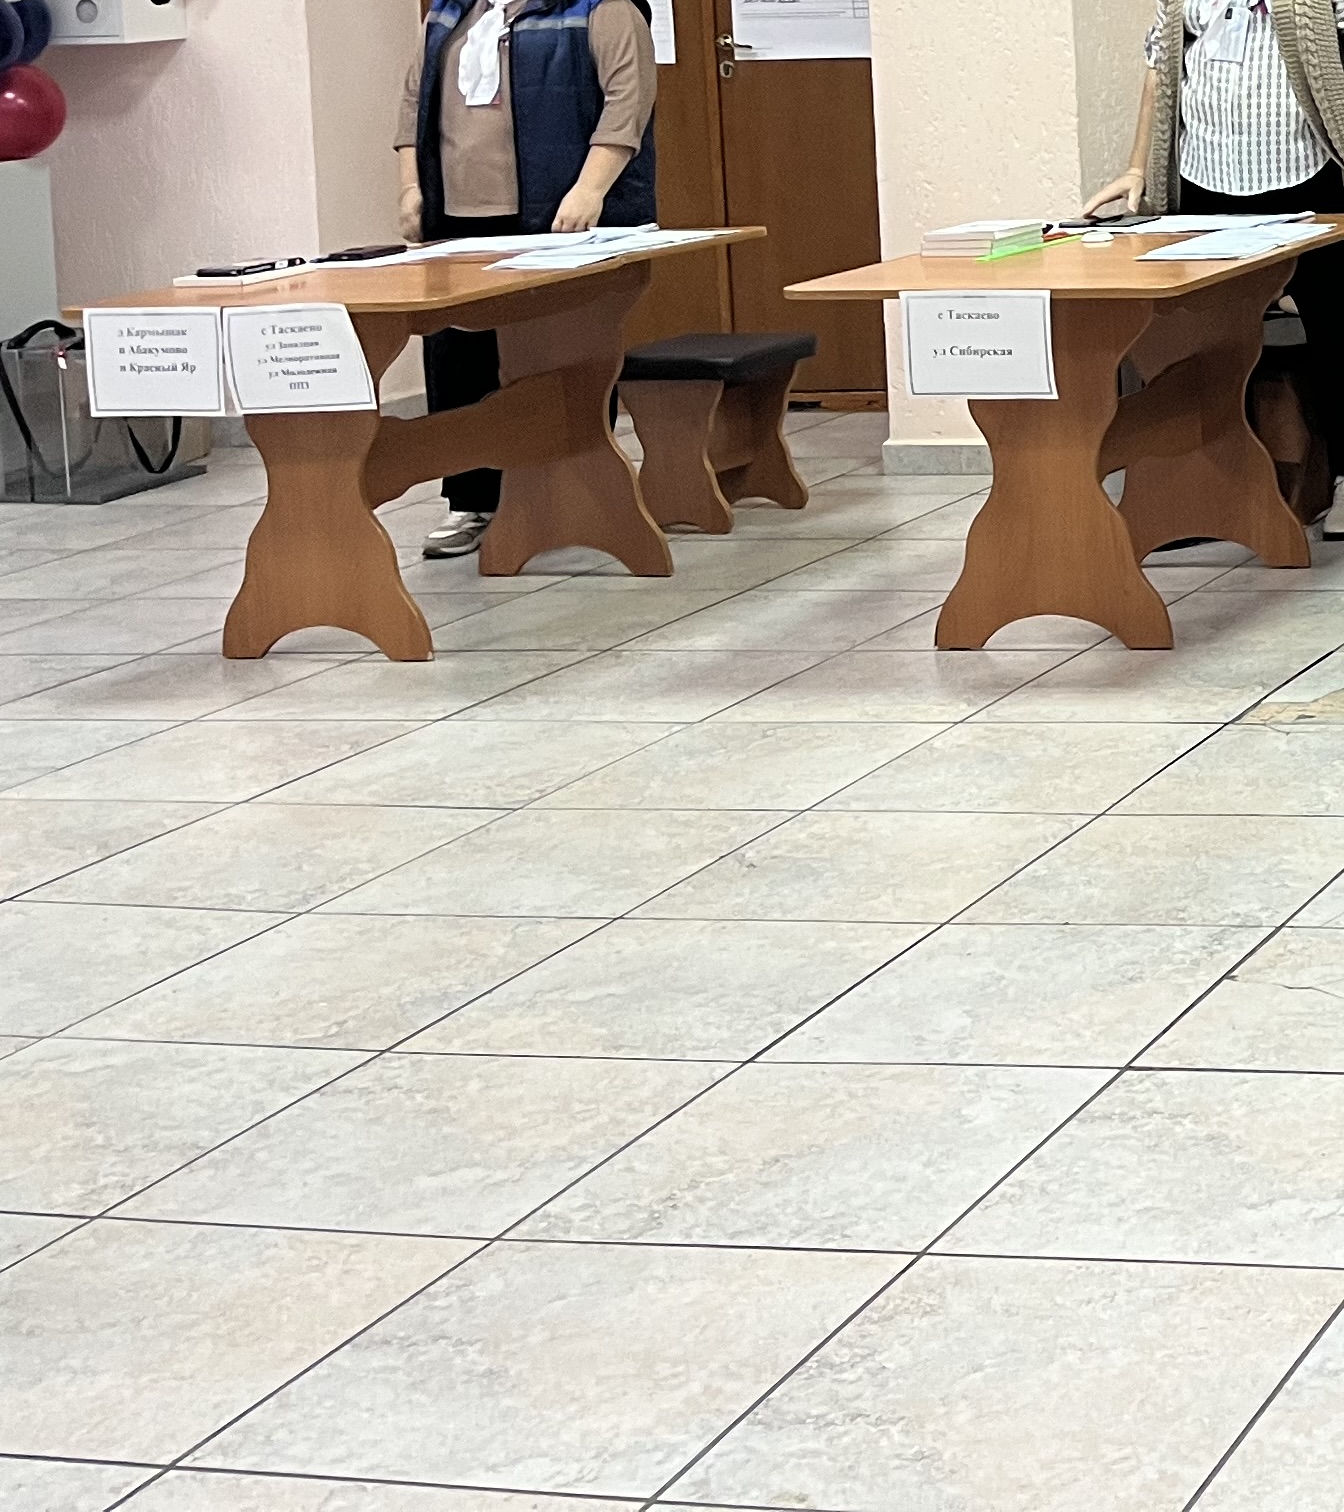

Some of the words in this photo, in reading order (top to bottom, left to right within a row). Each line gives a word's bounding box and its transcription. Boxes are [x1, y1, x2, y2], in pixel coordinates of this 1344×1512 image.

[947, 309, 1000, 320] Таскаево
[271, 324, 323, 335] Таскаево
[932, 348, 946, 358] ул
[949, 345, 1013, 359] Сибирская
[129, 362, 178, 375] Красный
[180, 361, 197, 375] Яр
